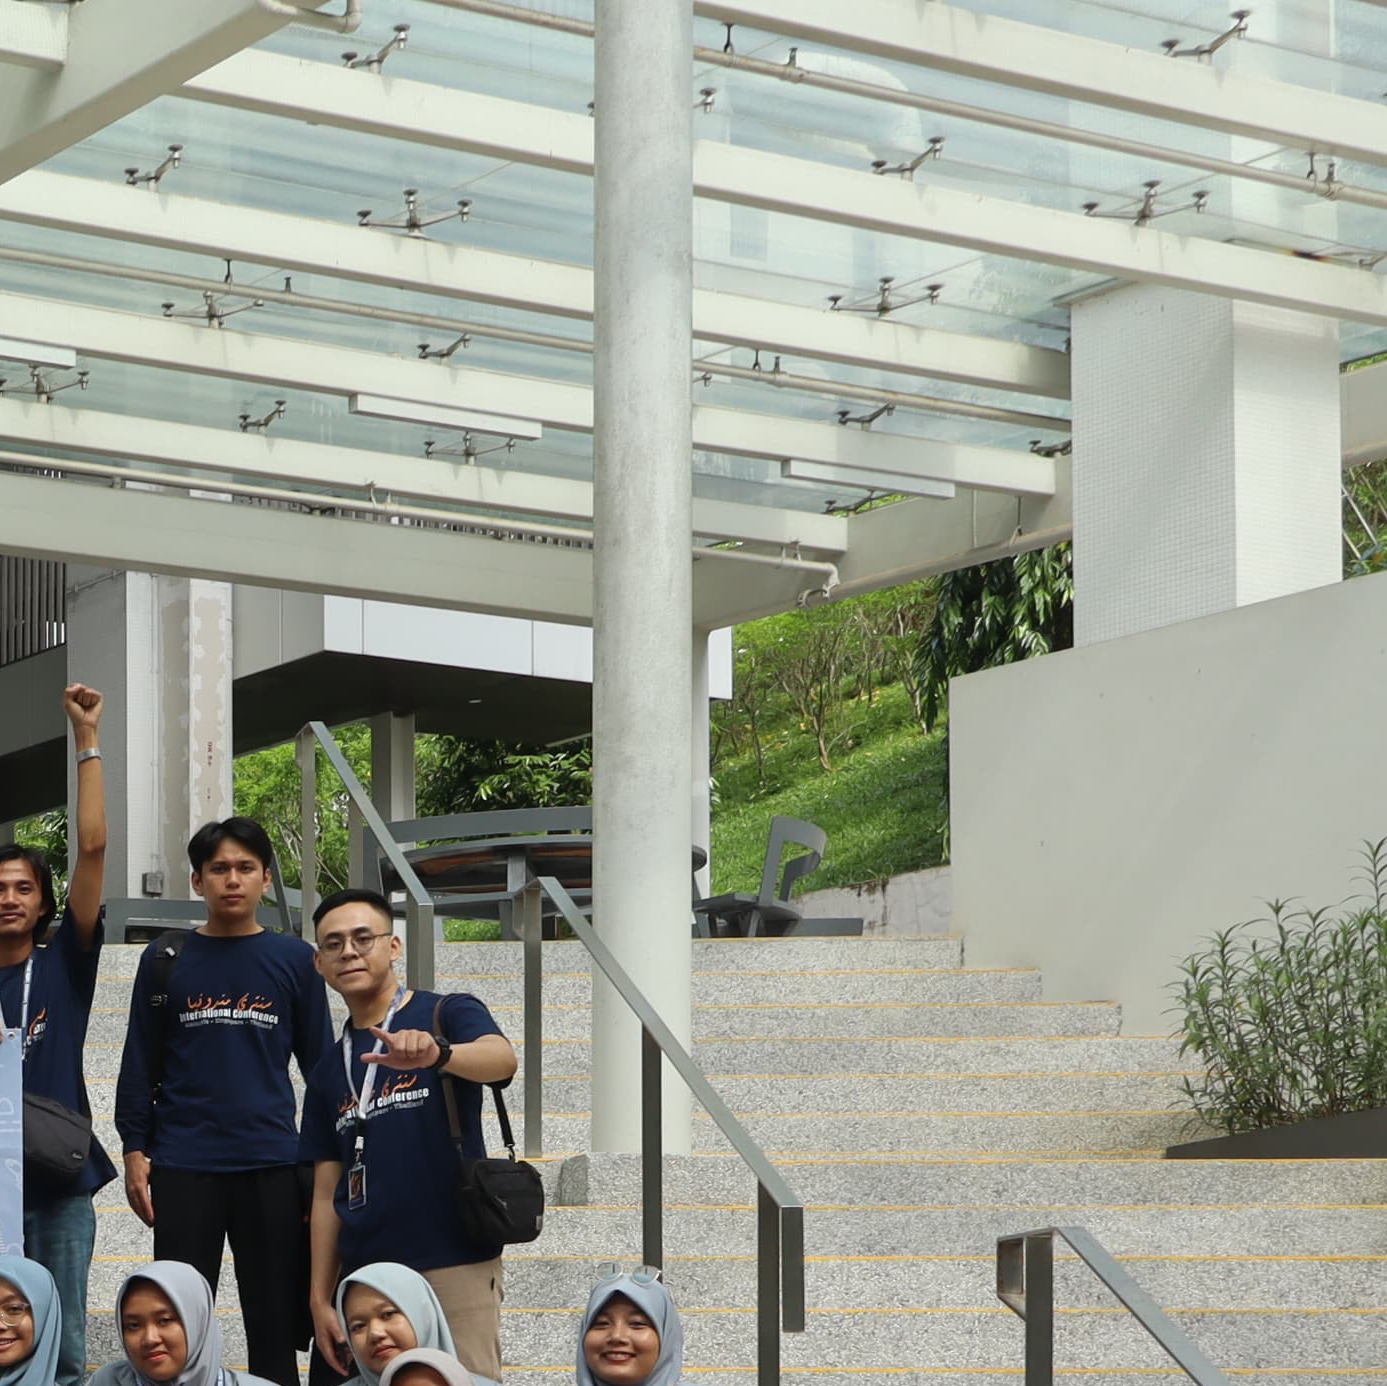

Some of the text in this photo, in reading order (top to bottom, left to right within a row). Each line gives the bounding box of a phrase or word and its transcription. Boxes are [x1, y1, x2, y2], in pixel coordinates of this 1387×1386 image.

[178, 1007, 279, 1025] International Conference
[377, 1087, 430, 1108] Conference
